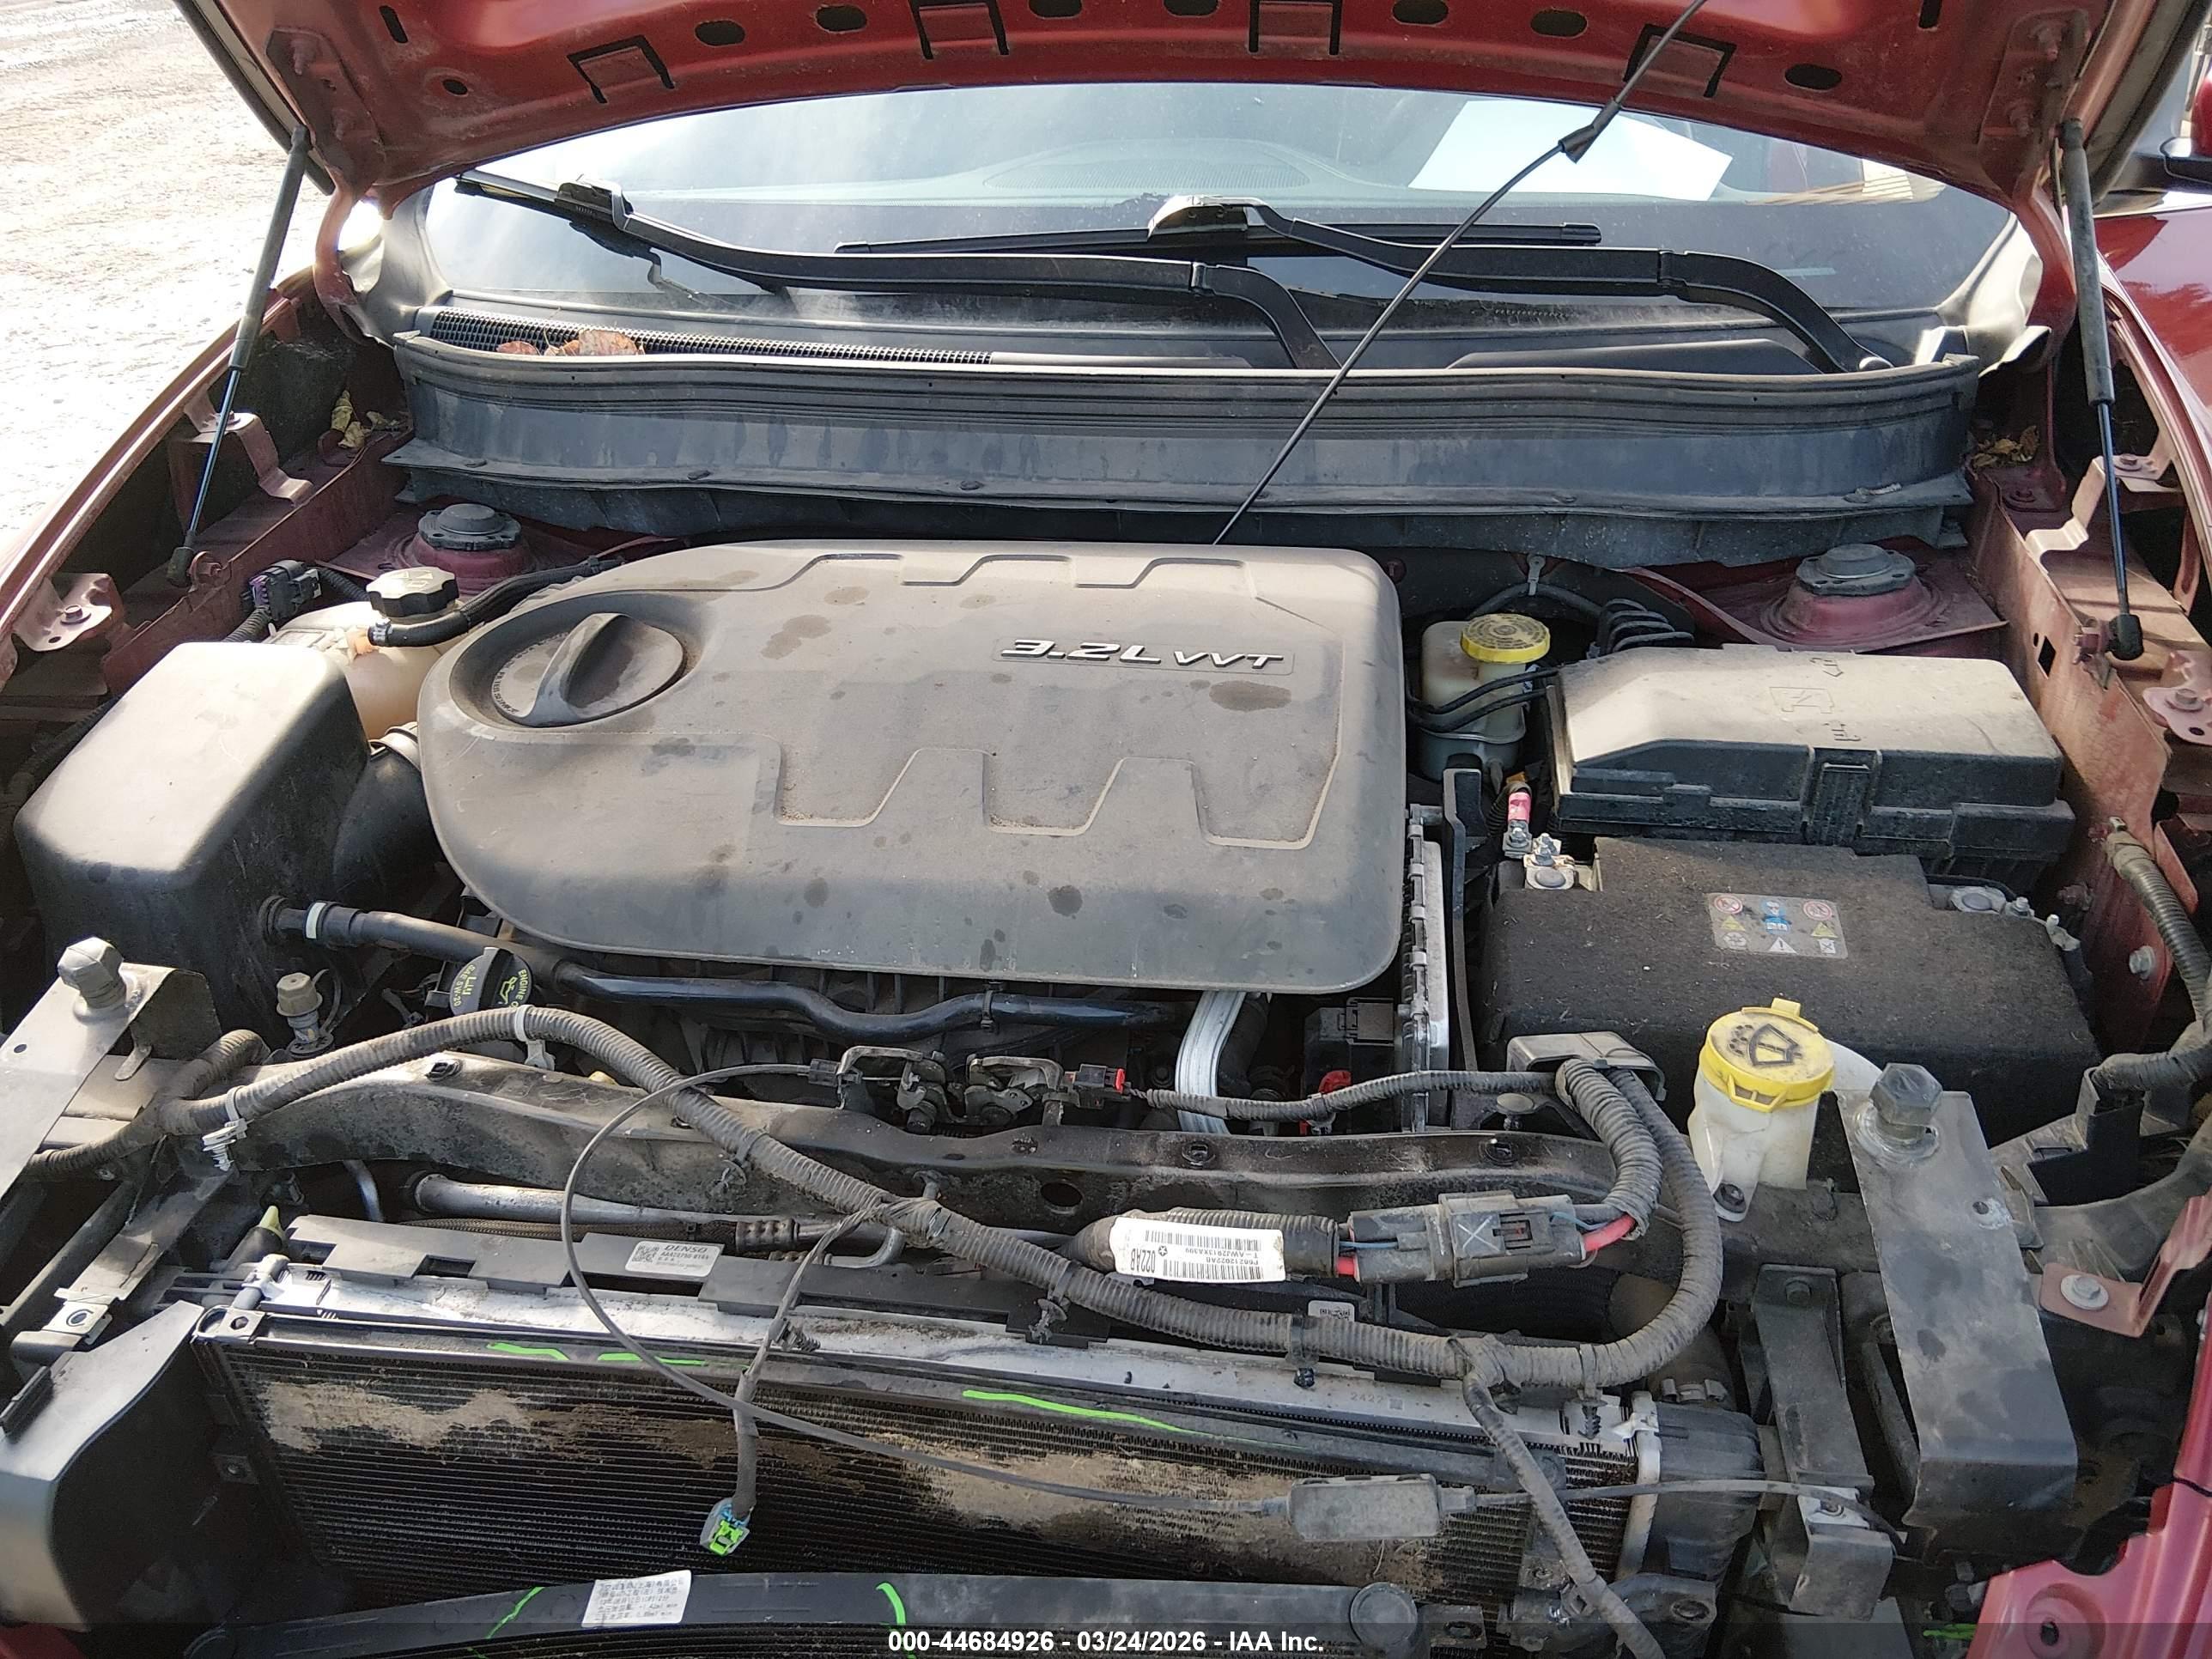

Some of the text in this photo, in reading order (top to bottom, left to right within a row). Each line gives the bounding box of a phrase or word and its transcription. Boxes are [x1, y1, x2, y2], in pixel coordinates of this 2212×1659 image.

[1001, 639, 1284, 670] 3.2L VVT
[453, 964, 476, 1007] SAE 5W-20
[515, 969, 530, 1000] ENGINE
[665, 1244, 708, 1254] DENSO
[1130, 1248, 1156, 1273] 022AB
